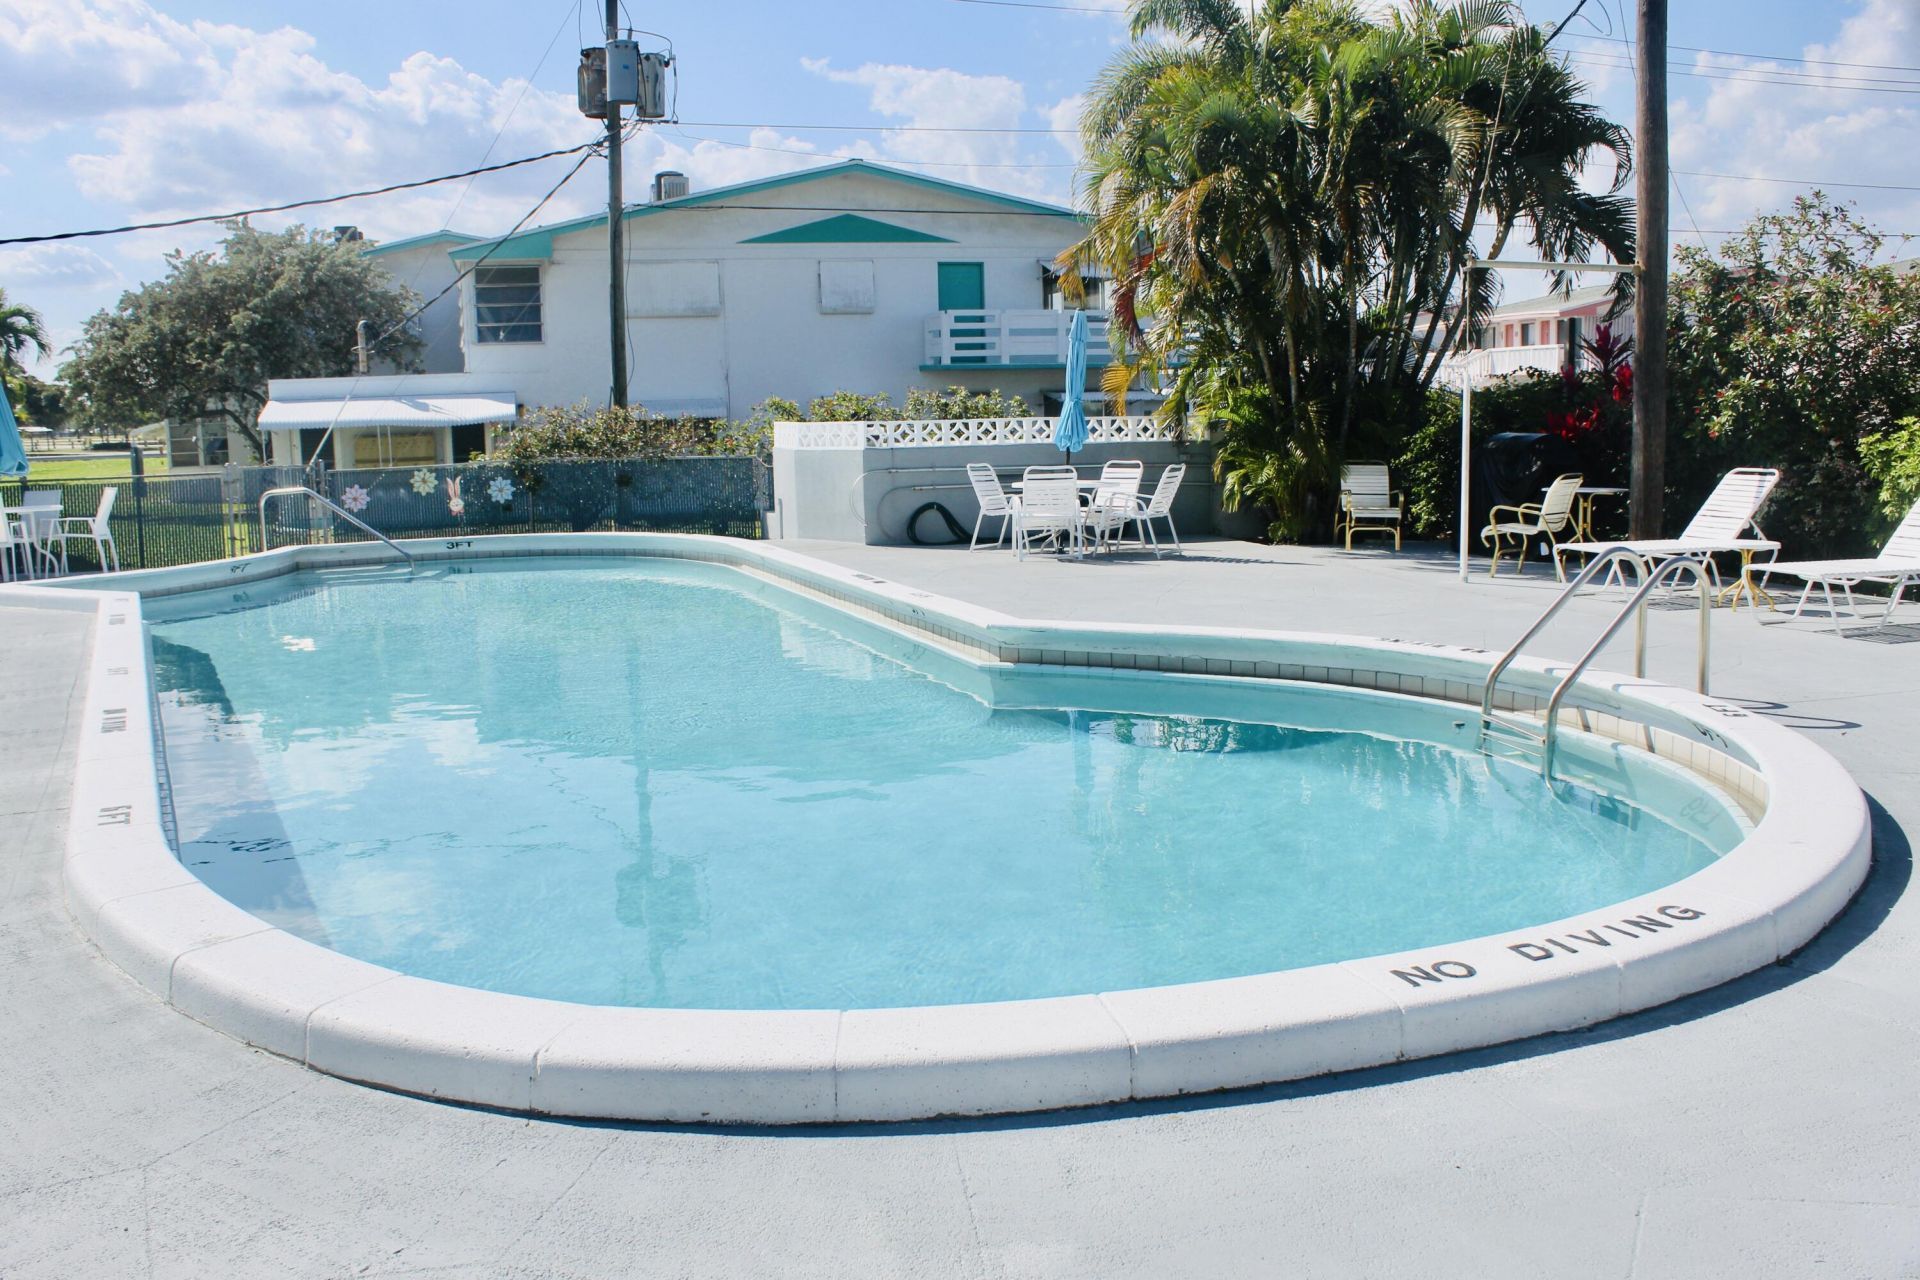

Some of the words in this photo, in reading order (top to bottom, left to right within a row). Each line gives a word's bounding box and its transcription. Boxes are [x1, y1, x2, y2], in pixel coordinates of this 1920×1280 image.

[446, 541, 474, 550] 3FT
[1389, 960, 1477, 987] NO
[1506, 905, 1707, 962] DIVING
